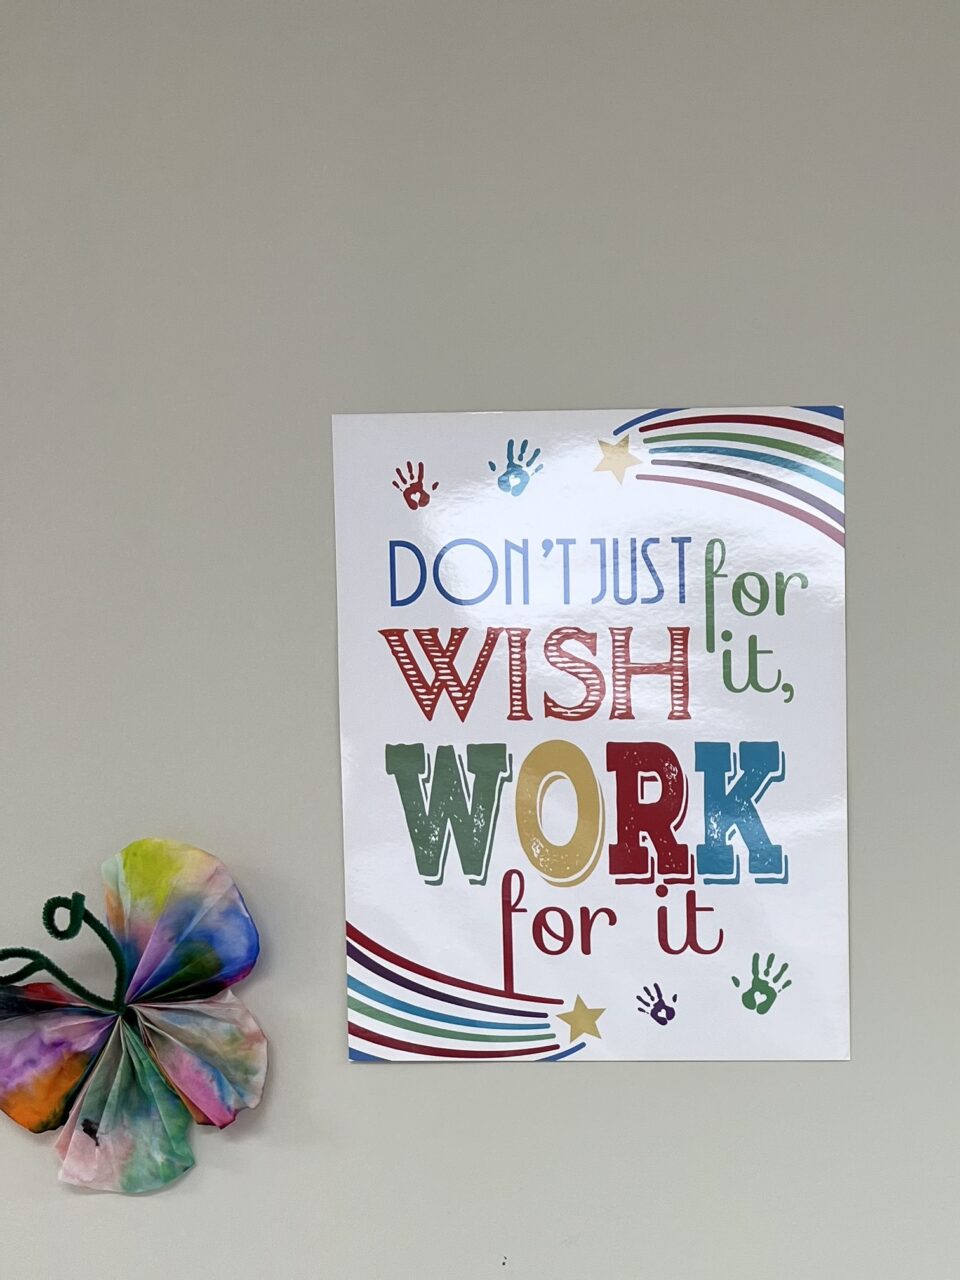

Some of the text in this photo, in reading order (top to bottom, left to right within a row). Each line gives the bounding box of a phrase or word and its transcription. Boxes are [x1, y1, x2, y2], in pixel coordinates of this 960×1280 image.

[388, 536, 692, 607] DON'T JUST
[705, 537, 809, 654] for
[377, 626, 693, 723] WISH
[720, 629, 796, 704] it,
[384, 739, 789, 887] WORK
[501, 868, 724, 995] for it
